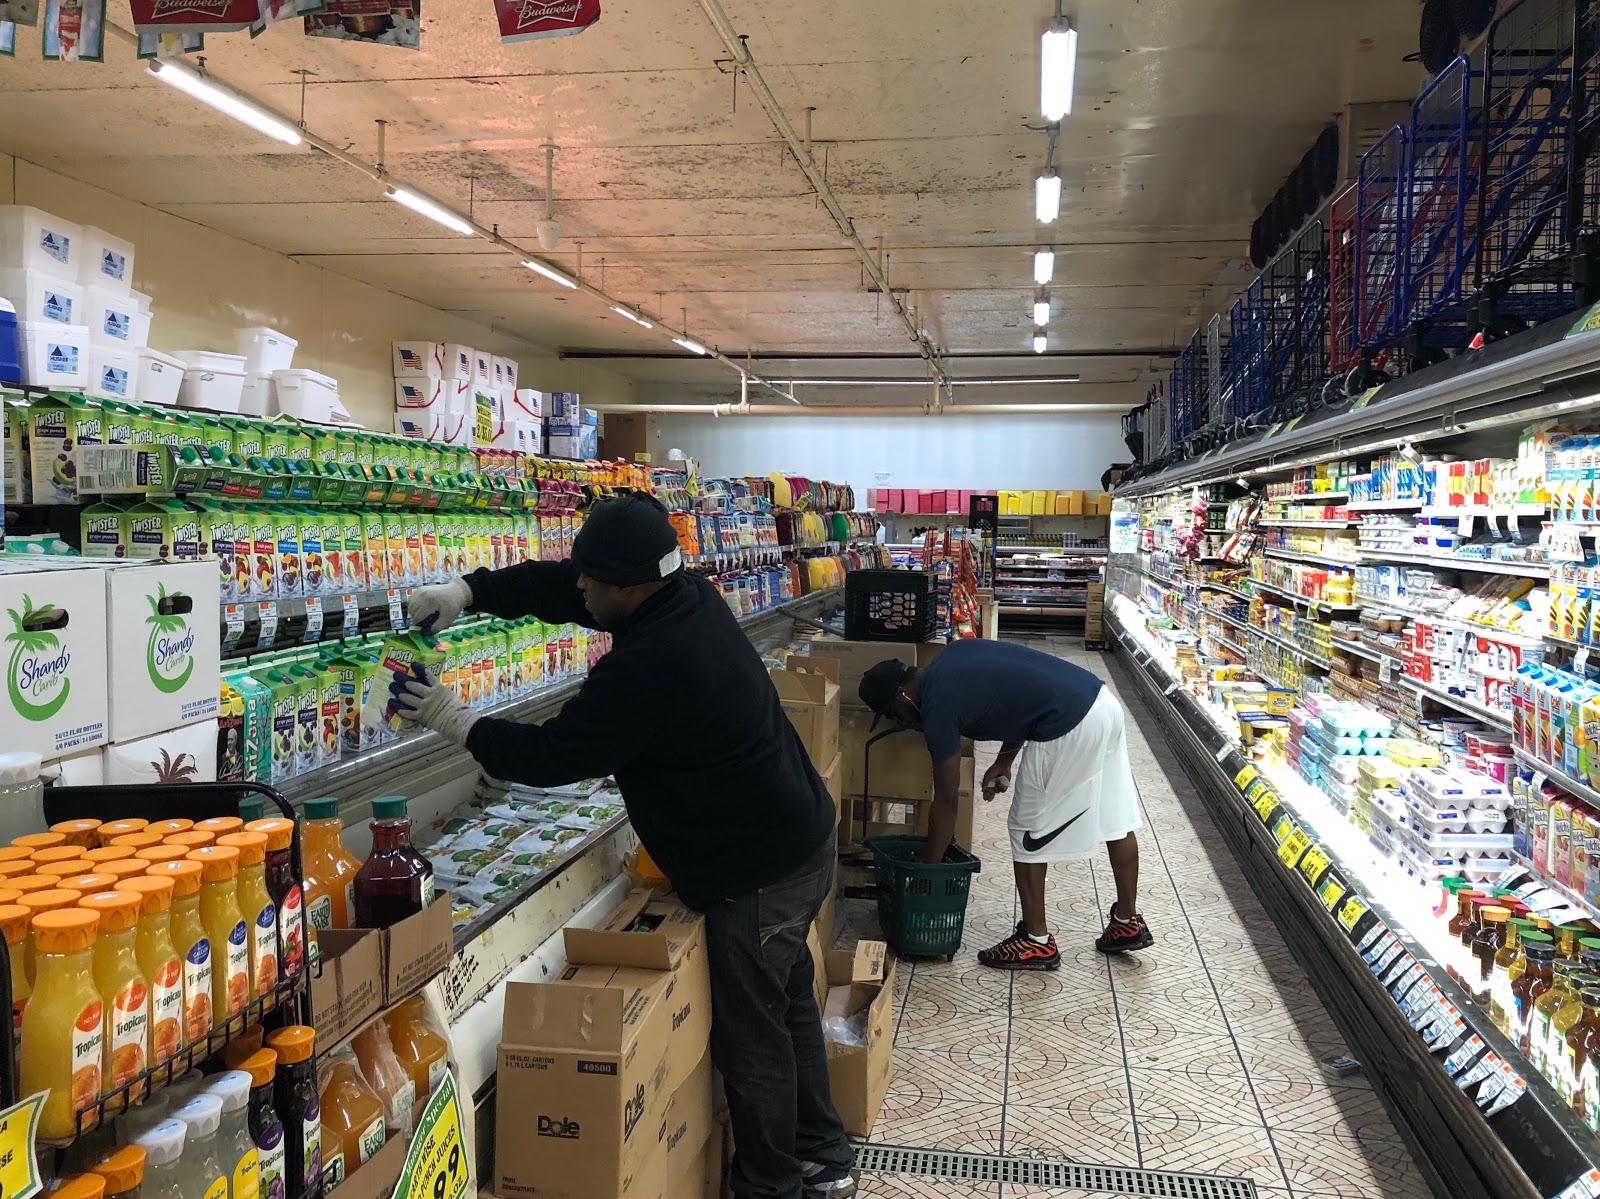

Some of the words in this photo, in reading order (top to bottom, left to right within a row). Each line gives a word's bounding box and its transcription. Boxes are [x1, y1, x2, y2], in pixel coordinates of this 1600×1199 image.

[518, 3, 583, 19] Budweiser
[34, 410, 66, 427] TWISTER
[108, 424, 131, 441] TWISTER
[131, 429, 153, 443] TWISTER
[239, 442, 261, 456] TWISTER
[267, 444, 287, 458] TWISTER
[147, 451, 162, 486] TWISTER
[87, 517, 118, 533] TWISTER
[132, 517, 161, 533] TWISTER
[172, 523, 197, 542] TWISTER
[210, 522, 234, 541] TWISTER
[234, 523, 250, 541] WISTER
[253, 523, 272, 541] TWISTER
[277, 524, 296, 541] TWISTER
[301, 524, 320, 541] TWISTER
[322, 524, 340, 540] TWISTER
[343, 524, 360, 540] TWISTER
[1564, 567, 1575, 577] Dole
[1577, 569, 1588, 579] Dole
[156, 627, 194, 665] Shandy
[389, 646, 413, 663] TWISTER
[20, 645, 70, 689] Shandy
[165, 654, 185, 672] Carib
[32, 673, 59, 697] Carib
[322, 683, 340, 703] TWISTER
[274, 695, 294, 718] TWISTER
[298, 688, 317, 710] TWISTER
[83, 723, 103, 732] BOTTLES
[64, 739, 79, 748] PACKS
[89, 733, 103, 741] LOOSE
[311, 905, 330, 922] EARTH
[258, 930, 276, 948] Tropican
[188, 967, 210, 987] Tropican
[155, 989, 181, 1011] Topicana
[115, 1014, 147, 1036] Tropicana
[672, 1002, 691, 1032] Tropicana
[75, 1033, 103, 1058] Tropican
[532, 1056, 555, 1064] CARTONS
[583, 1063, 611, 1072] 48500
[426, 1080, 453, 1124] Special
[625, 1083, 644, 1138] Dole
[538, 1115, 580, 1137] Dole
[364, 1131, 384, 1151] EARTH
[420, 1134, 436, 1164] WISE
[259, 1149, 284, 1172] Tropicana
[419, 1157, 437, 1194] PUNCH
[435, 1124, 456, 1163] JUICES
[502, 1183, 536, 1193] CONCENTRATE
